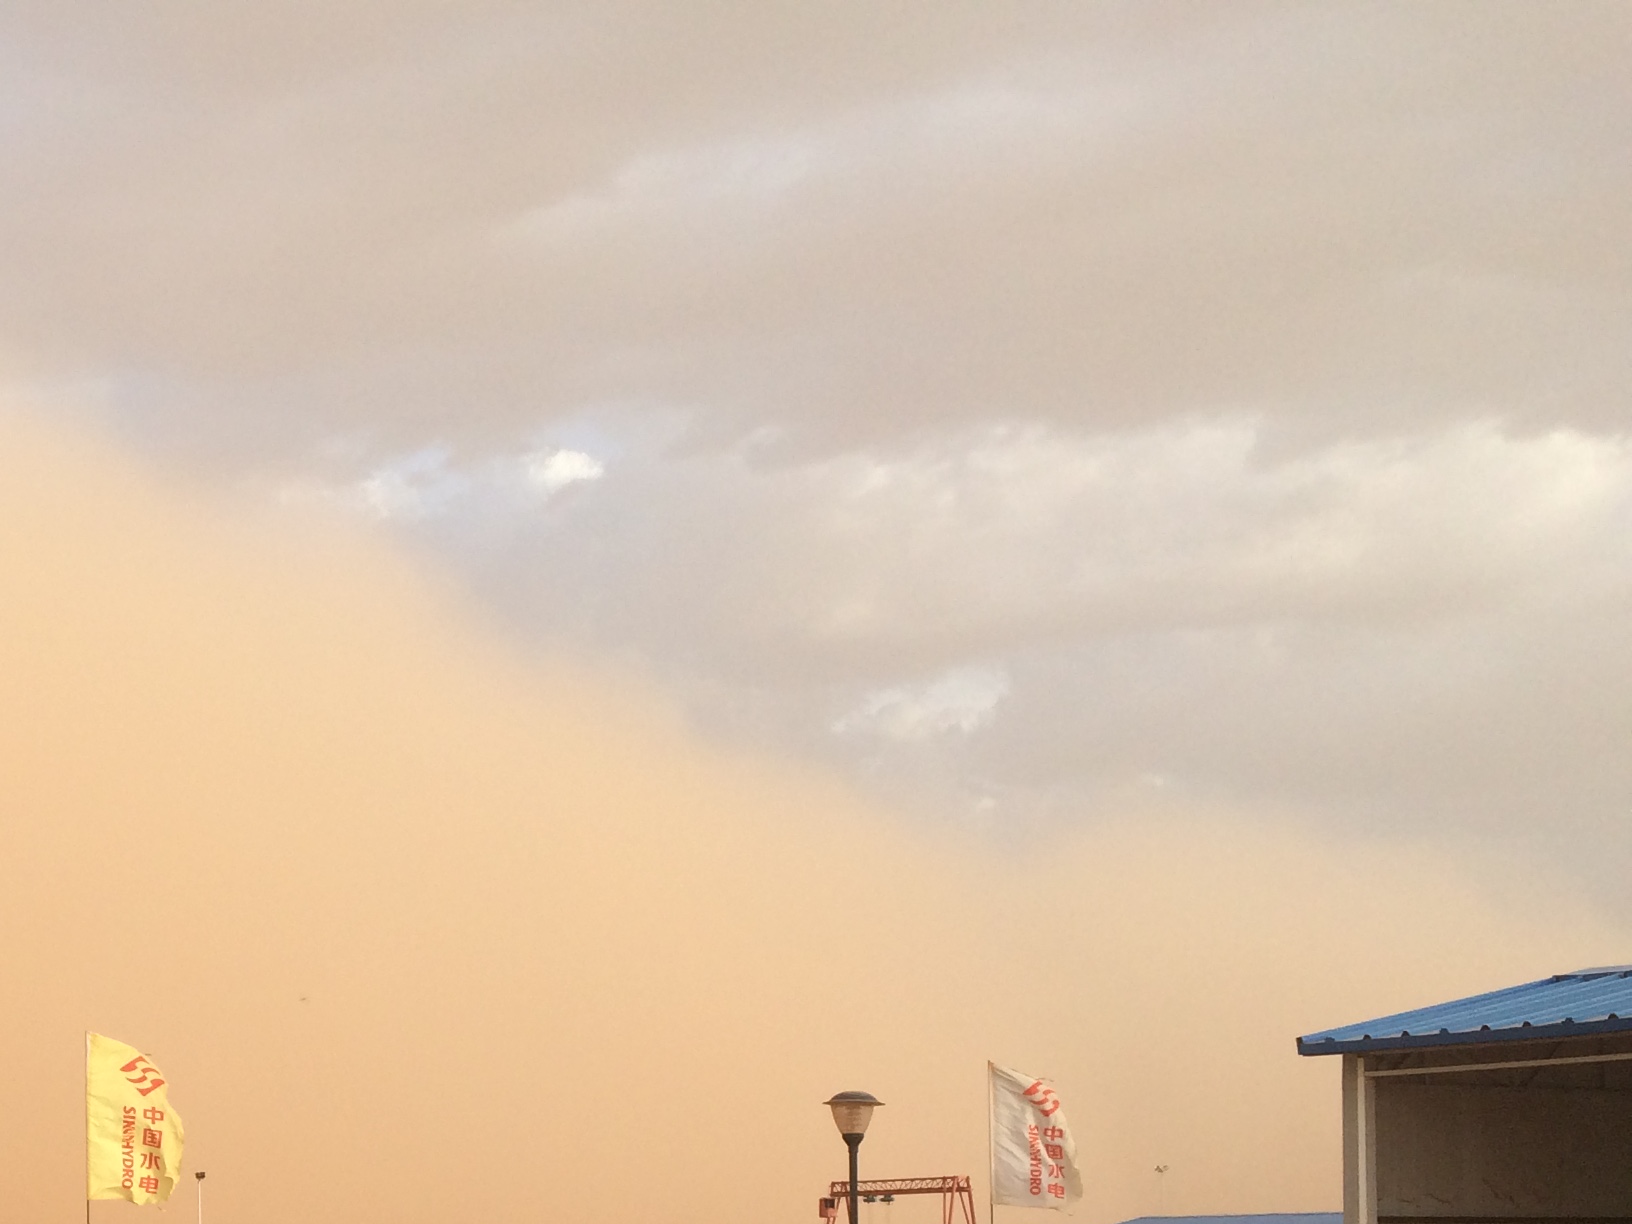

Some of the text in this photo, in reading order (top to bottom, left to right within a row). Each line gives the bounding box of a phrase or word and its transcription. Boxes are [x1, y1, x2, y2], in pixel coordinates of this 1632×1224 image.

[139, 1107, 164, 1192] 中国水电
[1044, 1126, 1065, 1199] 中国水电
